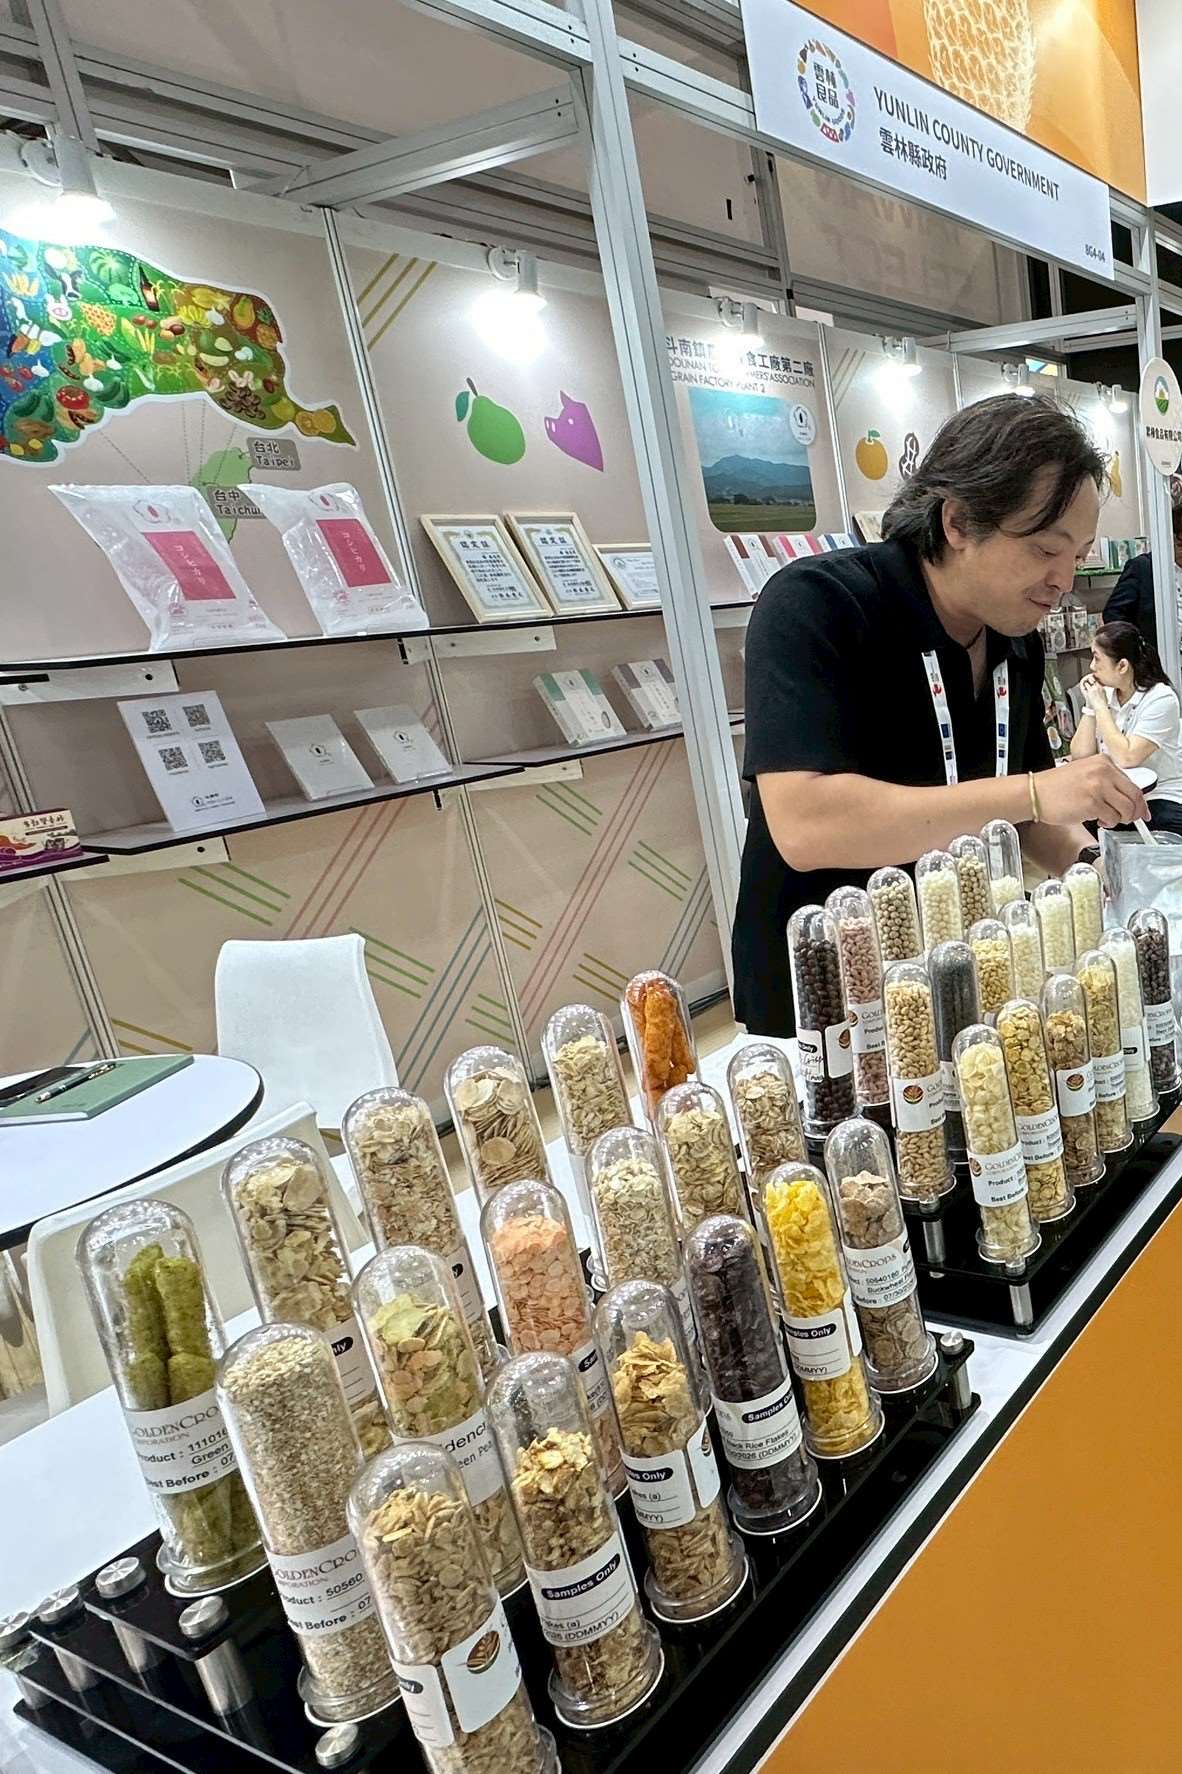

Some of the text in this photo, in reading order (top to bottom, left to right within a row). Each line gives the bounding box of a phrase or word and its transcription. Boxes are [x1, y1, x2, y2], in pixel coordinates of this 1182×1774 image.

[873, 86, 930, 136] YUNLIN
[932, 119, 983, 162] COUNTY
[986, 148, 1060, 201] GOVERNMENT
[879, 127, 947, 180] 雲林縣政府
[254, 441, 280, 454] 台北
[256, 455, 294, 467] Taipei
[214, 490, 240, 503] 台中
[216, 504, 261, 516] Taichu
[988, 1176, 1014, 1187] Product
[811, 1326, 832, 1338] Only
[747, 1403, 784, 1422] Samples
[745, 1440, 764, 1449] Rice
[191, 1443, 229, 1465] Green
[166, 1470, 210, 1488] Before
[642, 1471, 667, 1481] Only
[546, 1560, 618, 1599] Samples Only
[304, 1614, 348, 1630] Before
